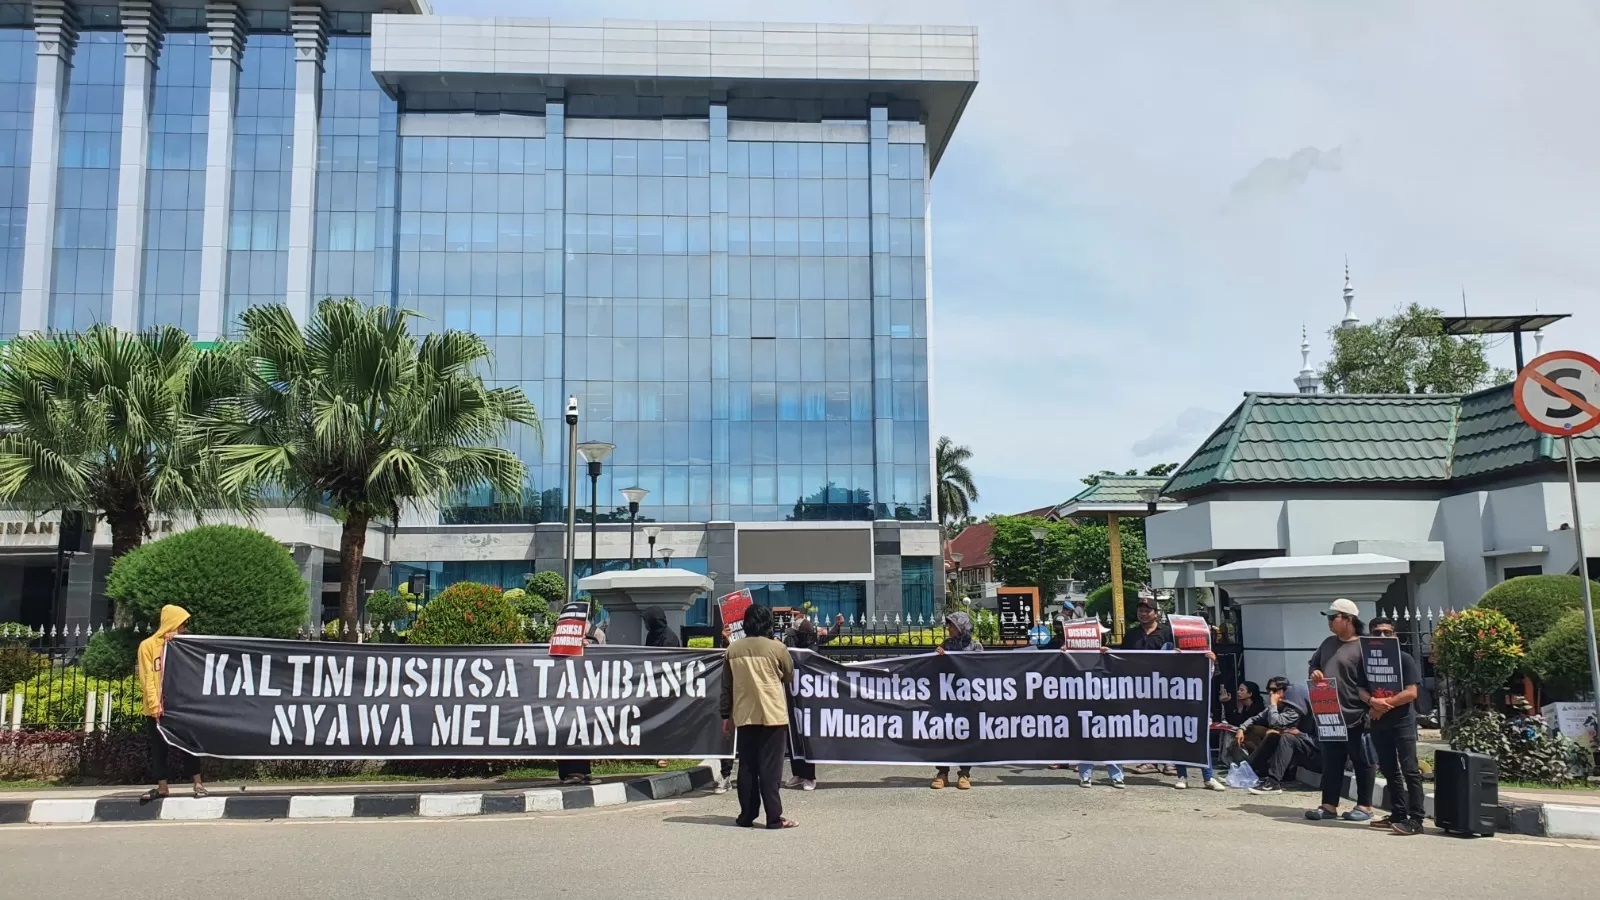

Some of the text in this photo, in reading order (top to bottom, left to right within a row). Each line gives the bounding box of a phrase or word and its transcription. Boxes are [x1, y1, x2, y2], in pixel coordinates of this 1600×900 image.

[1540, 368, 1587, 419] S
[552, 636, 583, 647] TAMBANG
[555, 624, 583, 635] DISIKSA
[1067, 627, 1097, 638] DISIKSA
[1067, 638, 1100, 648] TAMBANG
[202, 653, 707, 702] KALTIM DISIKSA TAMBANG
[846, 671, 931, 701] Tuntas
[939, 672, 1018, 702] Kasus
[1025, 671, 1203, 701] Pembunuhan
[270, 703, 641, 746] NYAWA MELAYANG
[820, 708, 903, 739] Muara
[912, 710, 970, 740] Kate
[979, 711, 1069, 740] karena
[1077, 709, 1198, 743] Tambang
